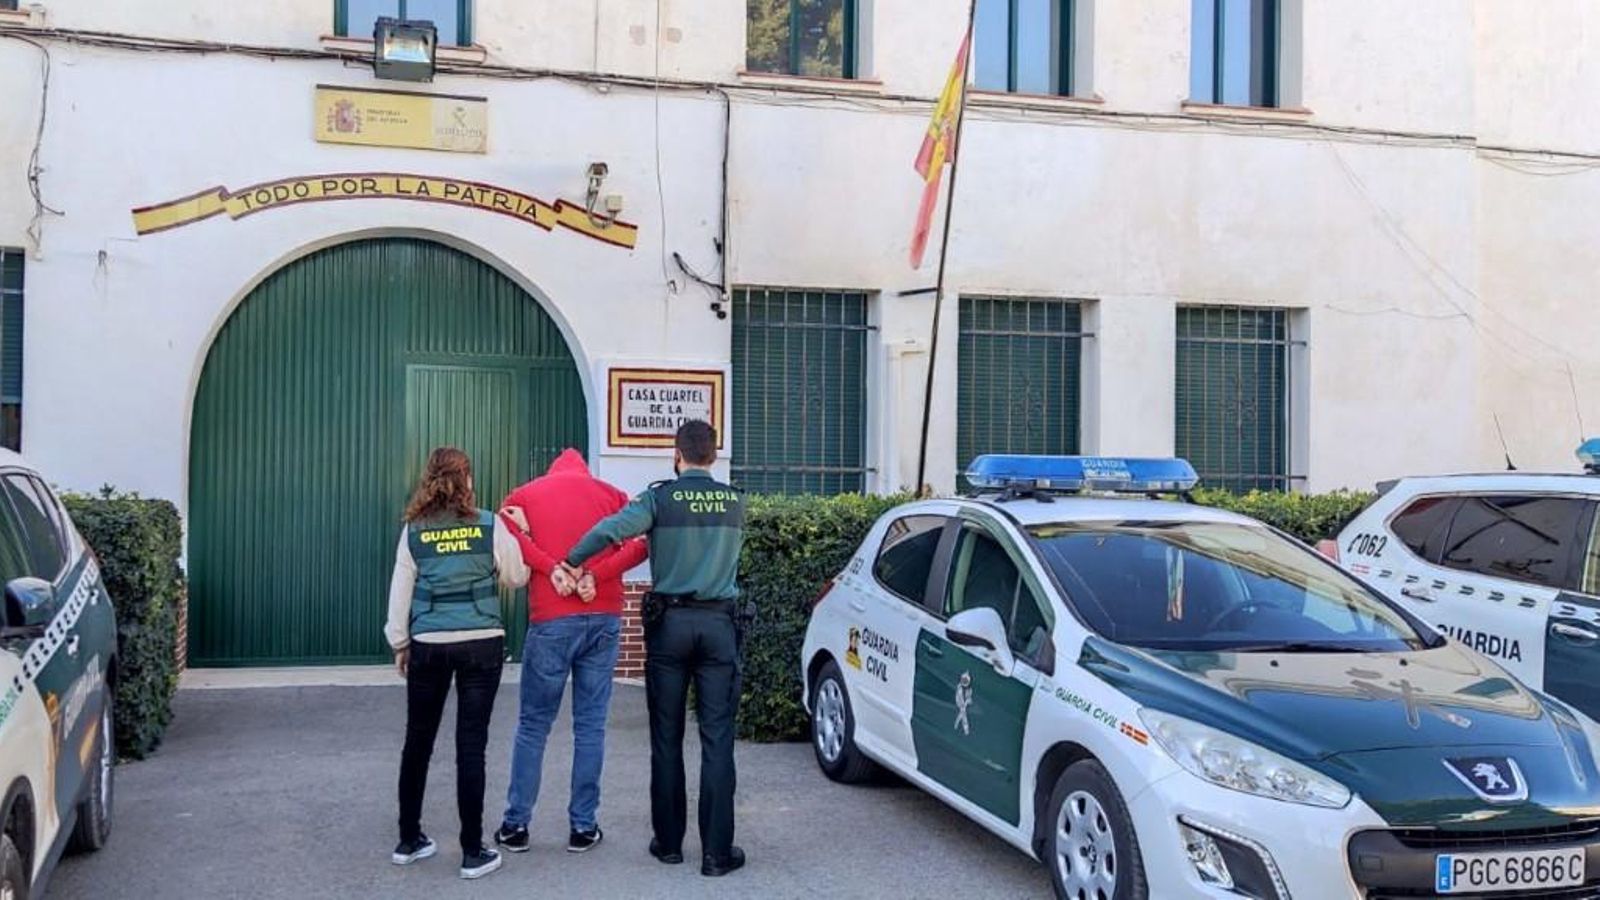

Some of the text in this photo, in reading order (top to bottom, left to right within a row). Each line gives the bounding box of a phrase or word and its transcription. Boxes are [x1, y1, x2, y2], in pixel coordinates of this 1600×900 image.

[237, 178, 537, 218] TODO POR LA PATRIA
[628, 388, 704, 403] CASA CUARTEL
[650, 404, 682, 414] DE LA
[628, 415, 673, 429] GUARDIA
[672, 490, 739, 502] GUARDIA
[690, 502, 727, 513] CIVIL
[420, 526, 482, 543] GUARDIA
[436, 540, 472, 553] CIVIL
[1358, 534, 1388, 557] 062
[862, 627, 899, 663] GUARDIA
[866, 655, 888, 682] CIVIL
[1055, 687, 1118, 729] GUARDIA CIVIL
